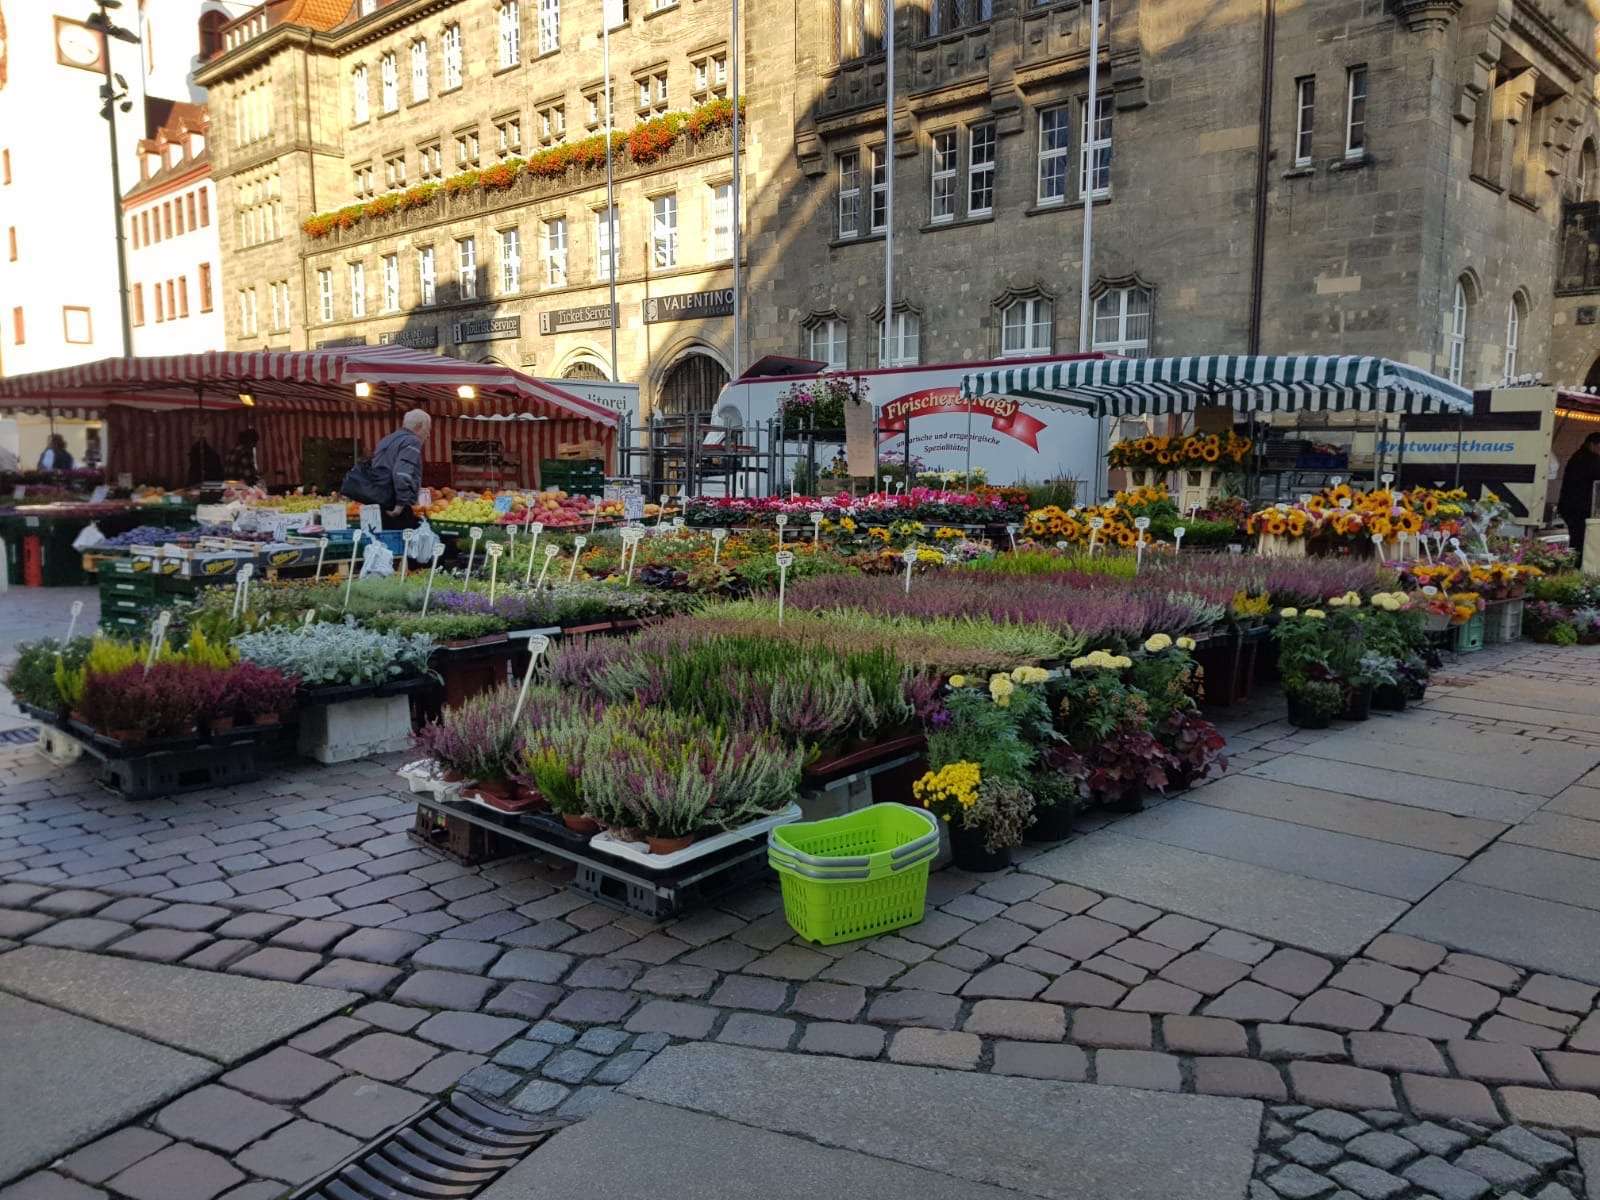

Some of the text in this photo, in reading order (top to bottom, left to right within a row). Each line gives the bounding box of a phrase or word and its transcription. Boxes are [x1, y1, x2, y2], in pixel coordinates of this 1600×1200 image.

[663, 289, 735, 311] VALENTINO
[558, 309, 584, 324] Ticket
[585, 307, 612, 321] Servic
[490, 318, 517, 333] Service
[934, 432, 948, 441] und
